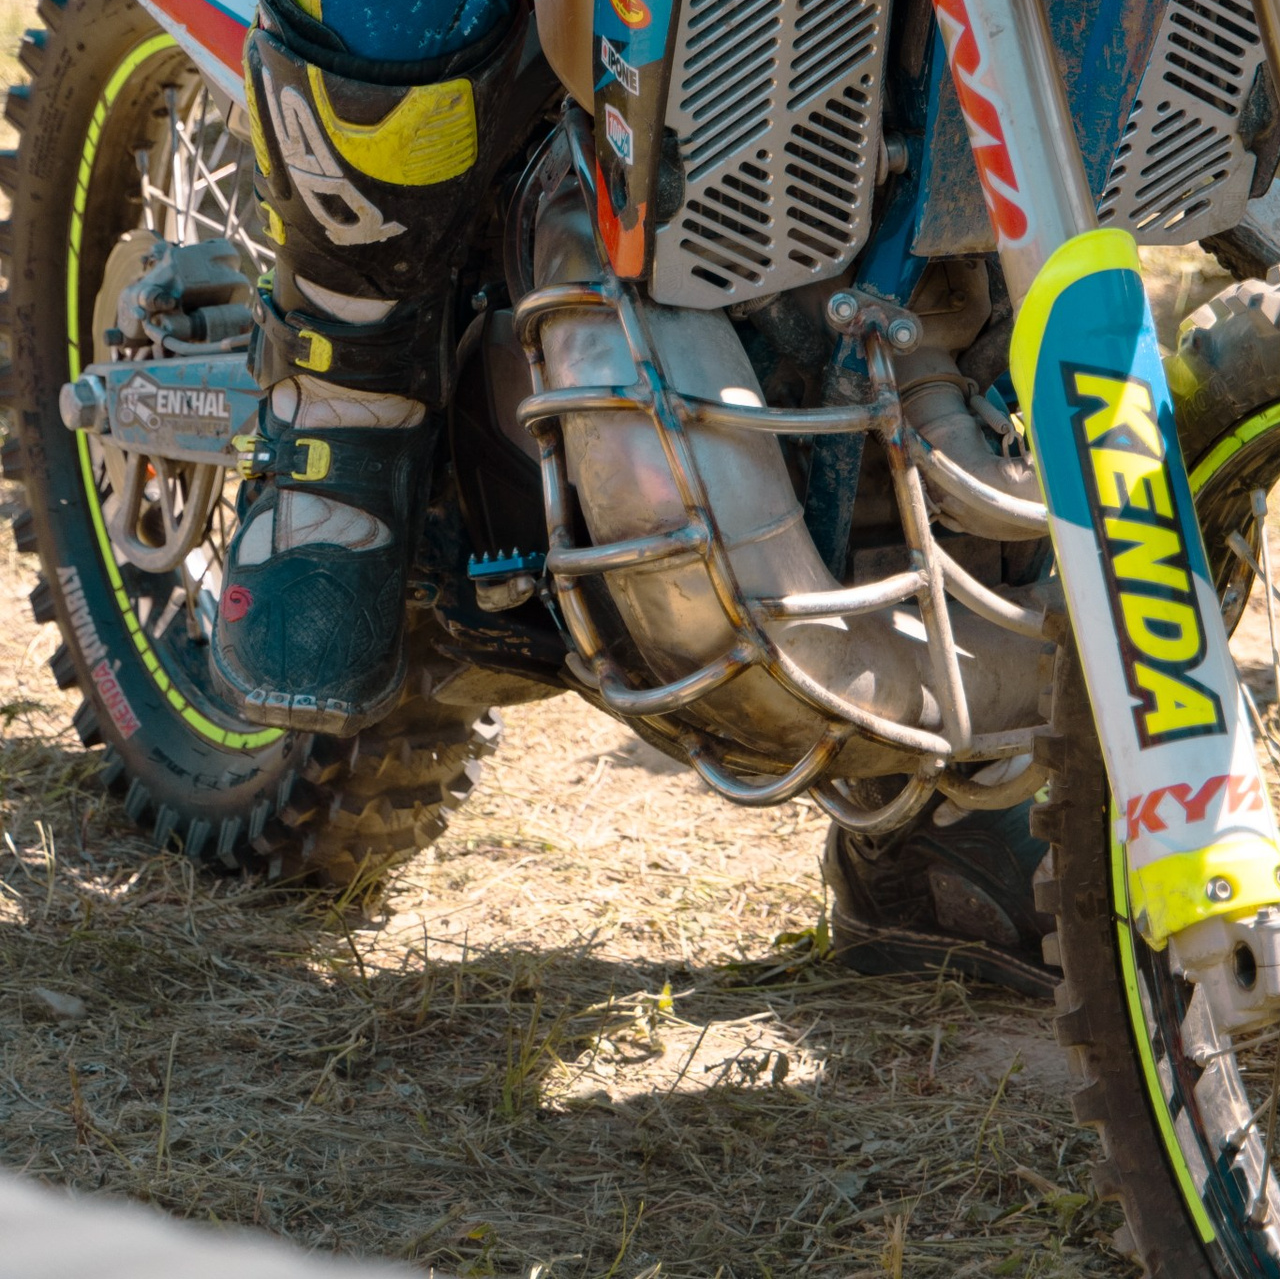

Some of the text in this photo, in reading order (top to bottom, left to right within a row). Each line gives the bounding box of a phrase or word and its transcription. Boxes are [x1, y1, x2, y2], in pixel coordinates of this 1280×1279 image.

[607, 43, 640, 92] IPONE
[608, 114, 631, 156] 100%
[1070, 371, 1224, 741] KENDA
